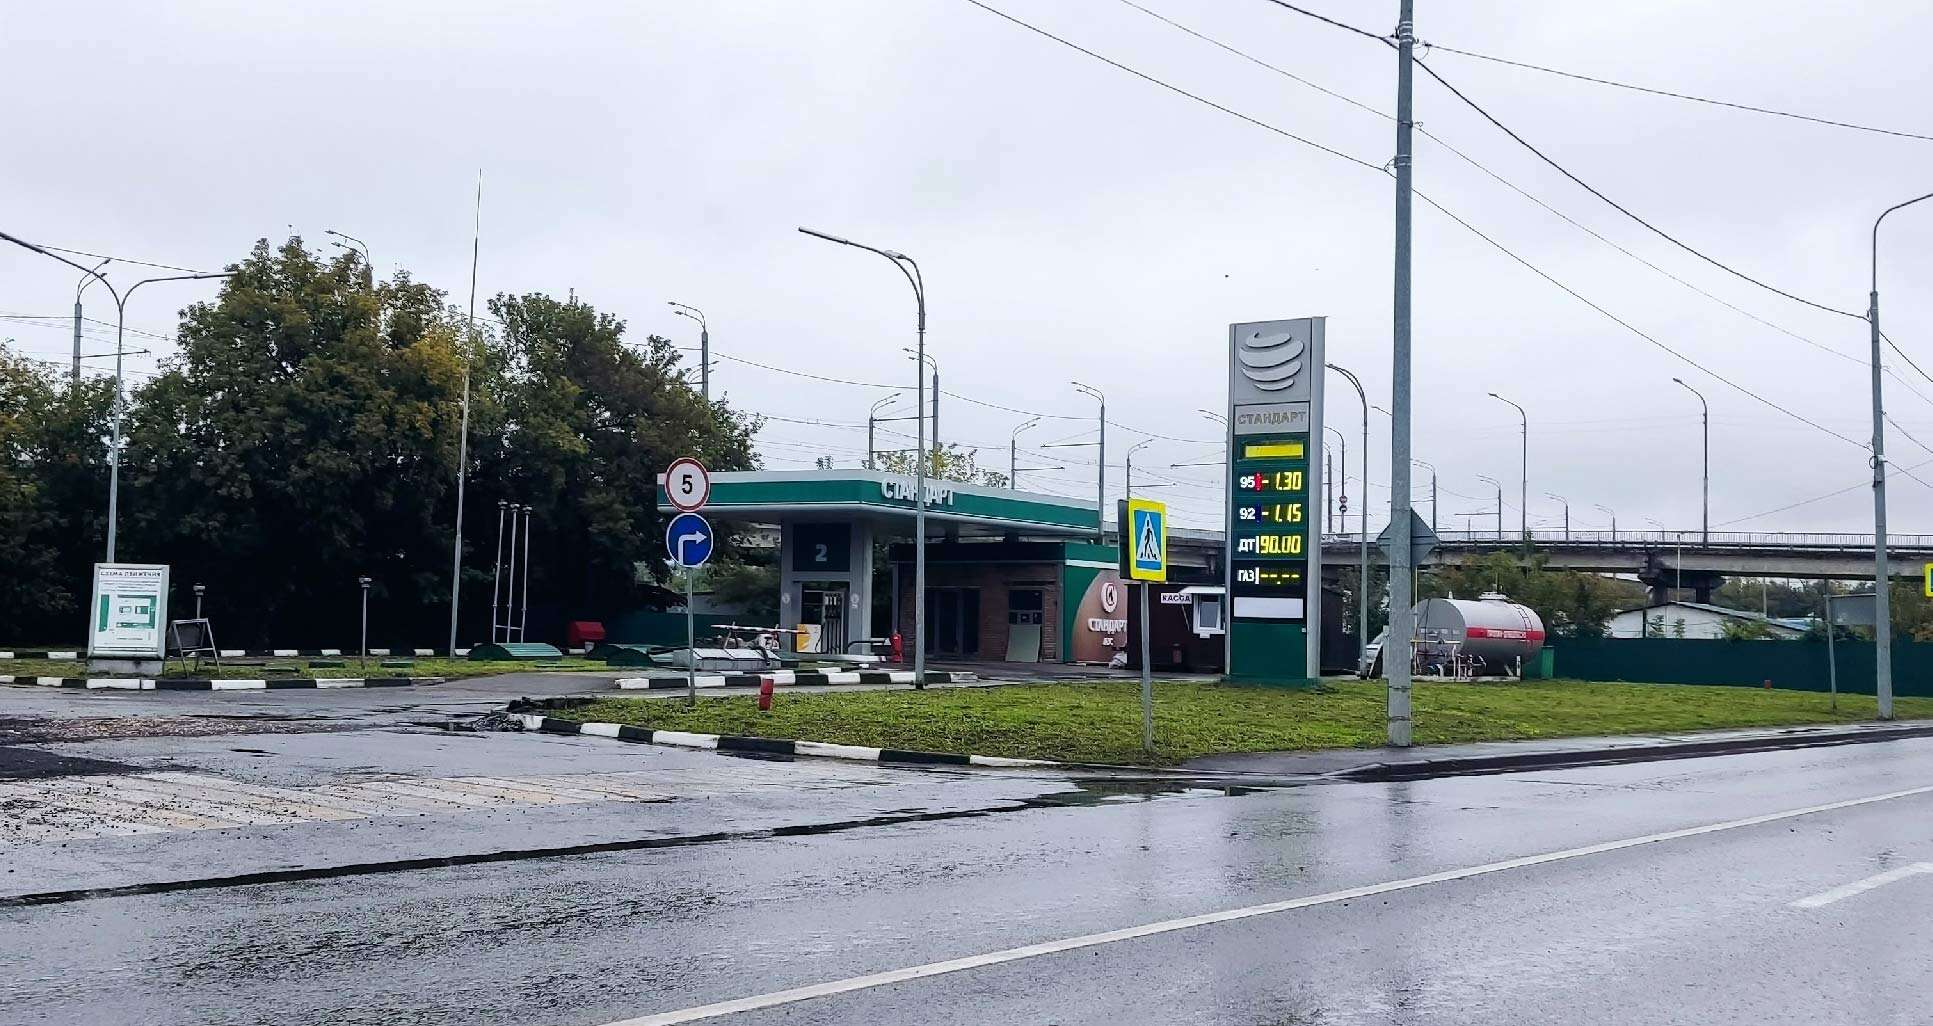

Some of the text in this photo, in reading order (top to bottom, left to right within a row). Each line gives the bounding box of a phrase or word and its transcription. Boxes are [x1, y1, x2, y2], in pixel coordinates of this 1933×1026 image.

[1237, 412, 1306, 425] СТАНДАРТ
[682, 474, 693, 495] 5
[1240, 476, 1255, 488] 95
[881, 480, 954, 507] СТАНДАРТ
[1240, 507, 1256, 520] 92
[1237, 535, 1302, 554] ДТ 90.00
[815, 544, 828, 562] 2
[1237, 569, 1255, 582] ГАЗ
[1162, 594, 1191, 602] КАССА
